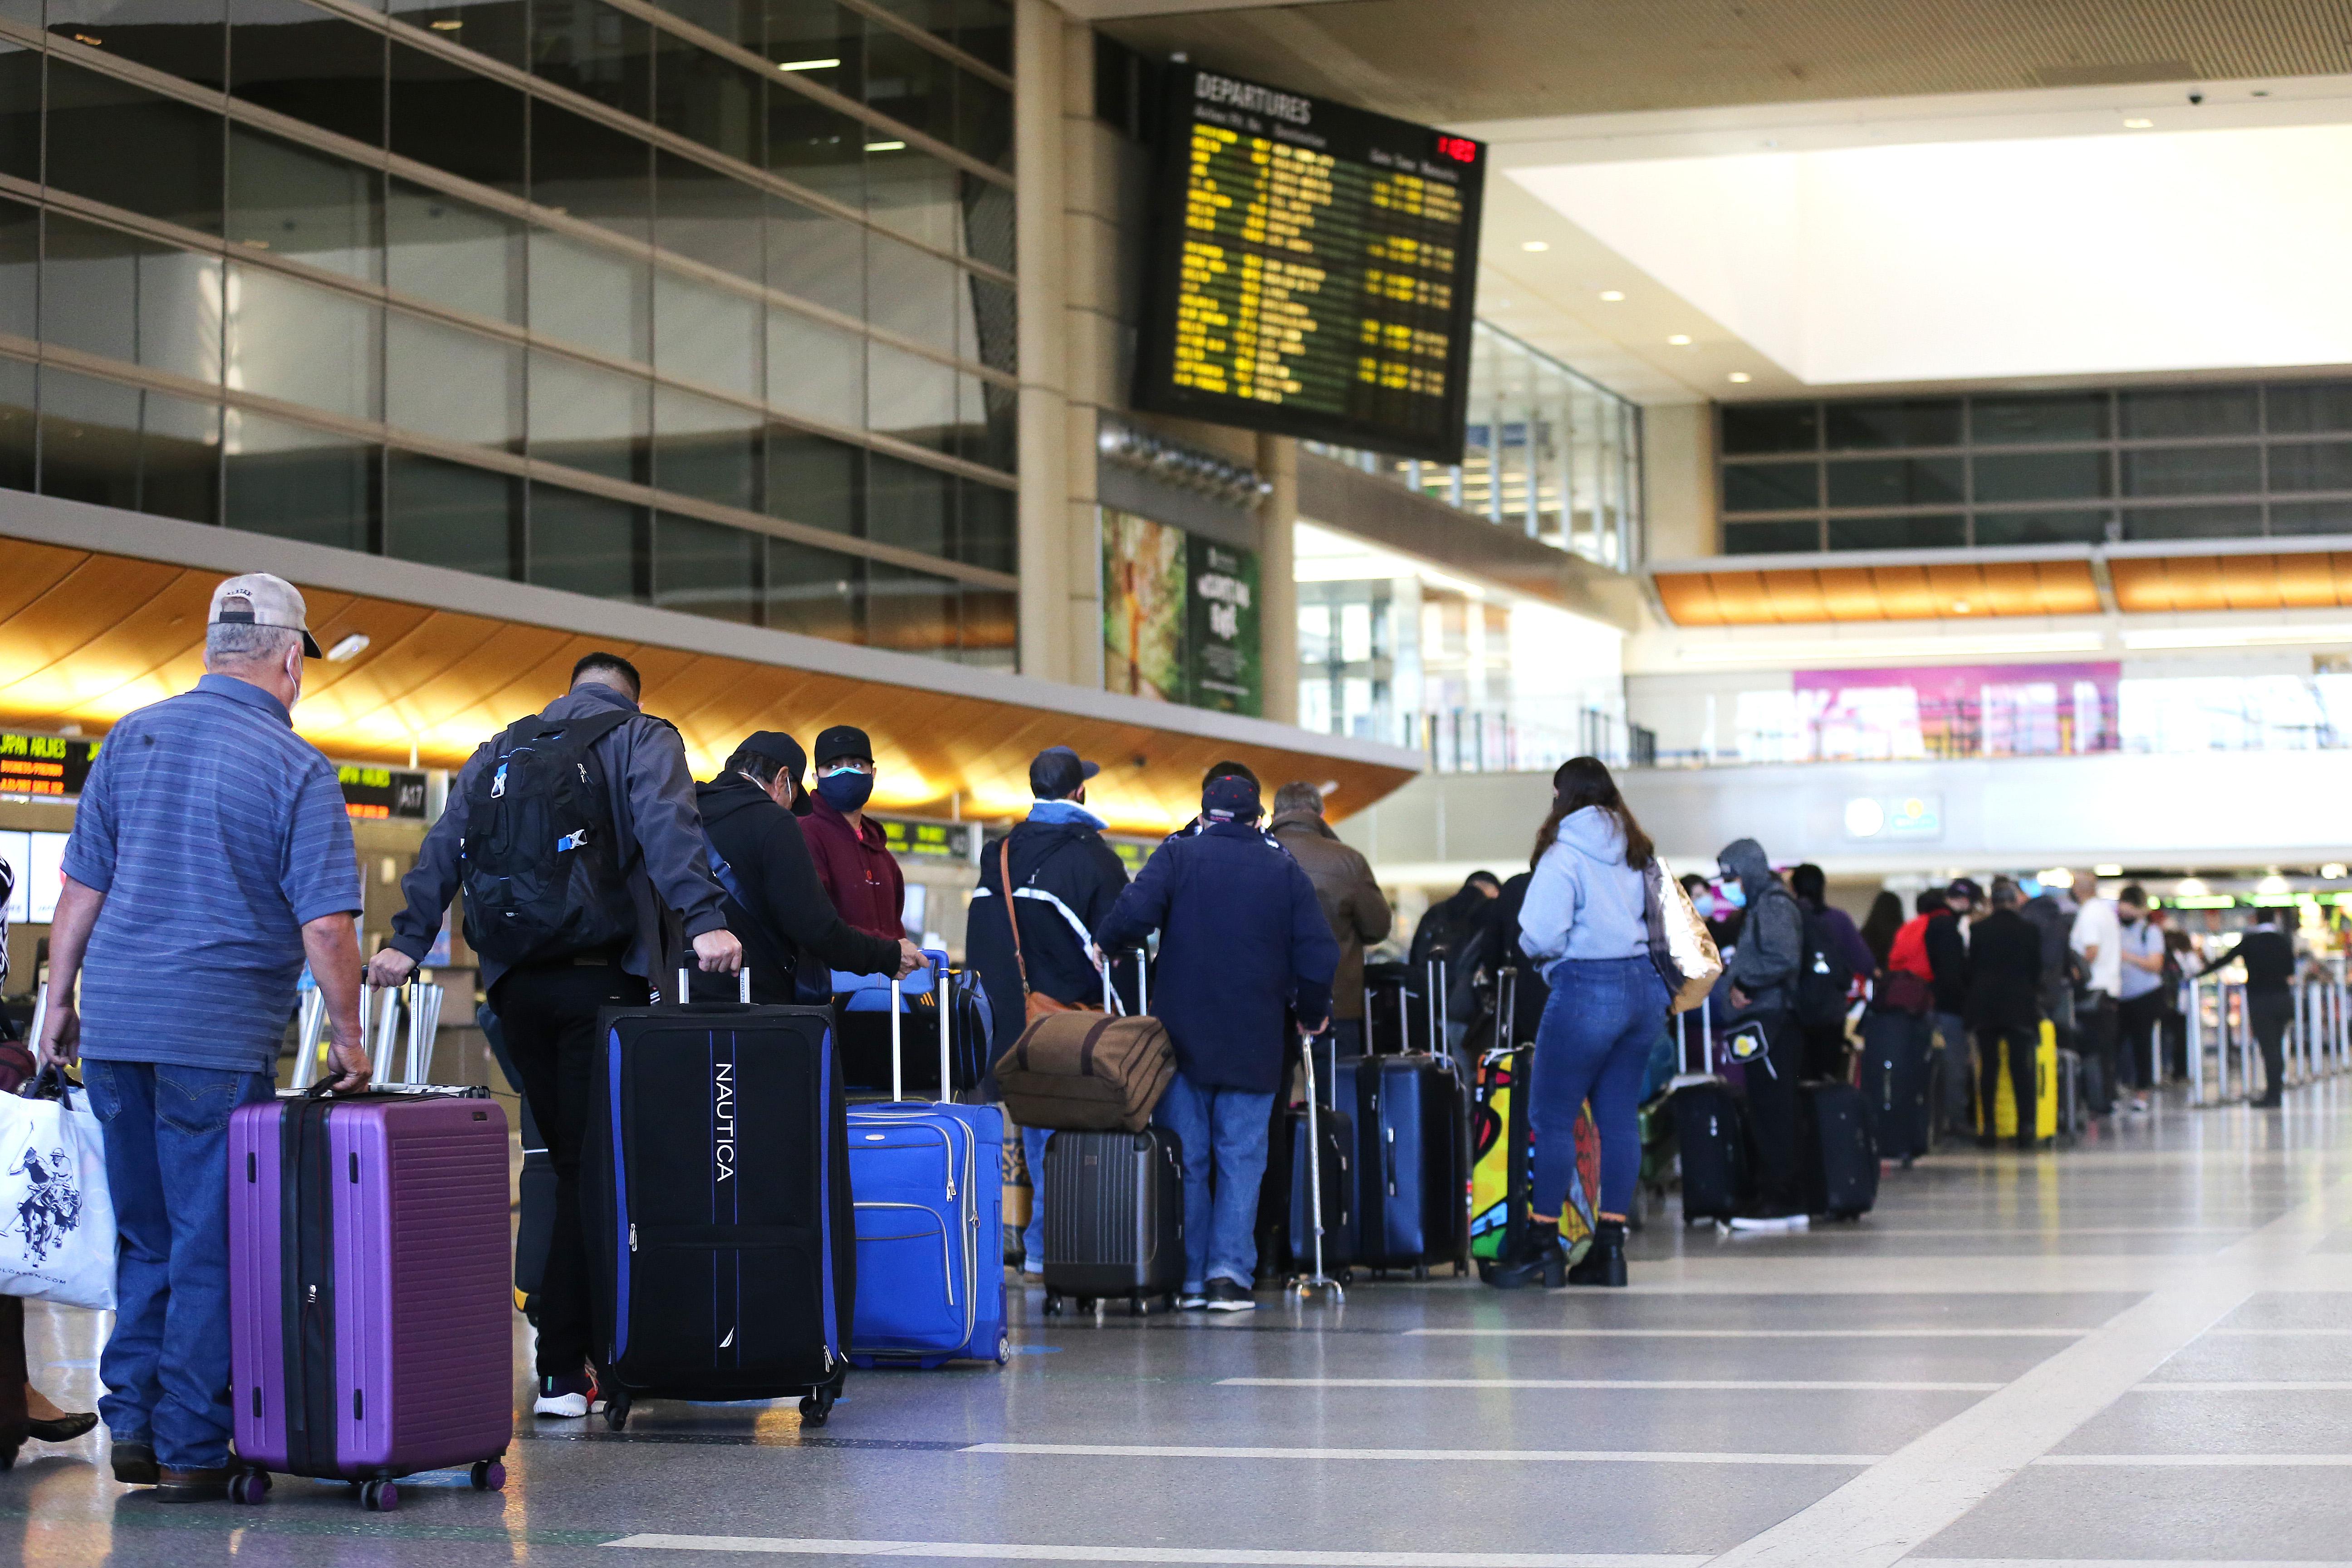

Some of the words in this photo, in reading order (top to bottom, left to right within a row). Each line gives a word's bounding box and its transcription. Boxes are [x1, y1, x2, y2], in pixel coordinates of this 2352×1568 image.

[1195, 72, 1312, 125] DEPARTURES
[716, 1063, 734, 1182] NAUTICA
[0, 1268, 66, 1285] LOASSN.COM
